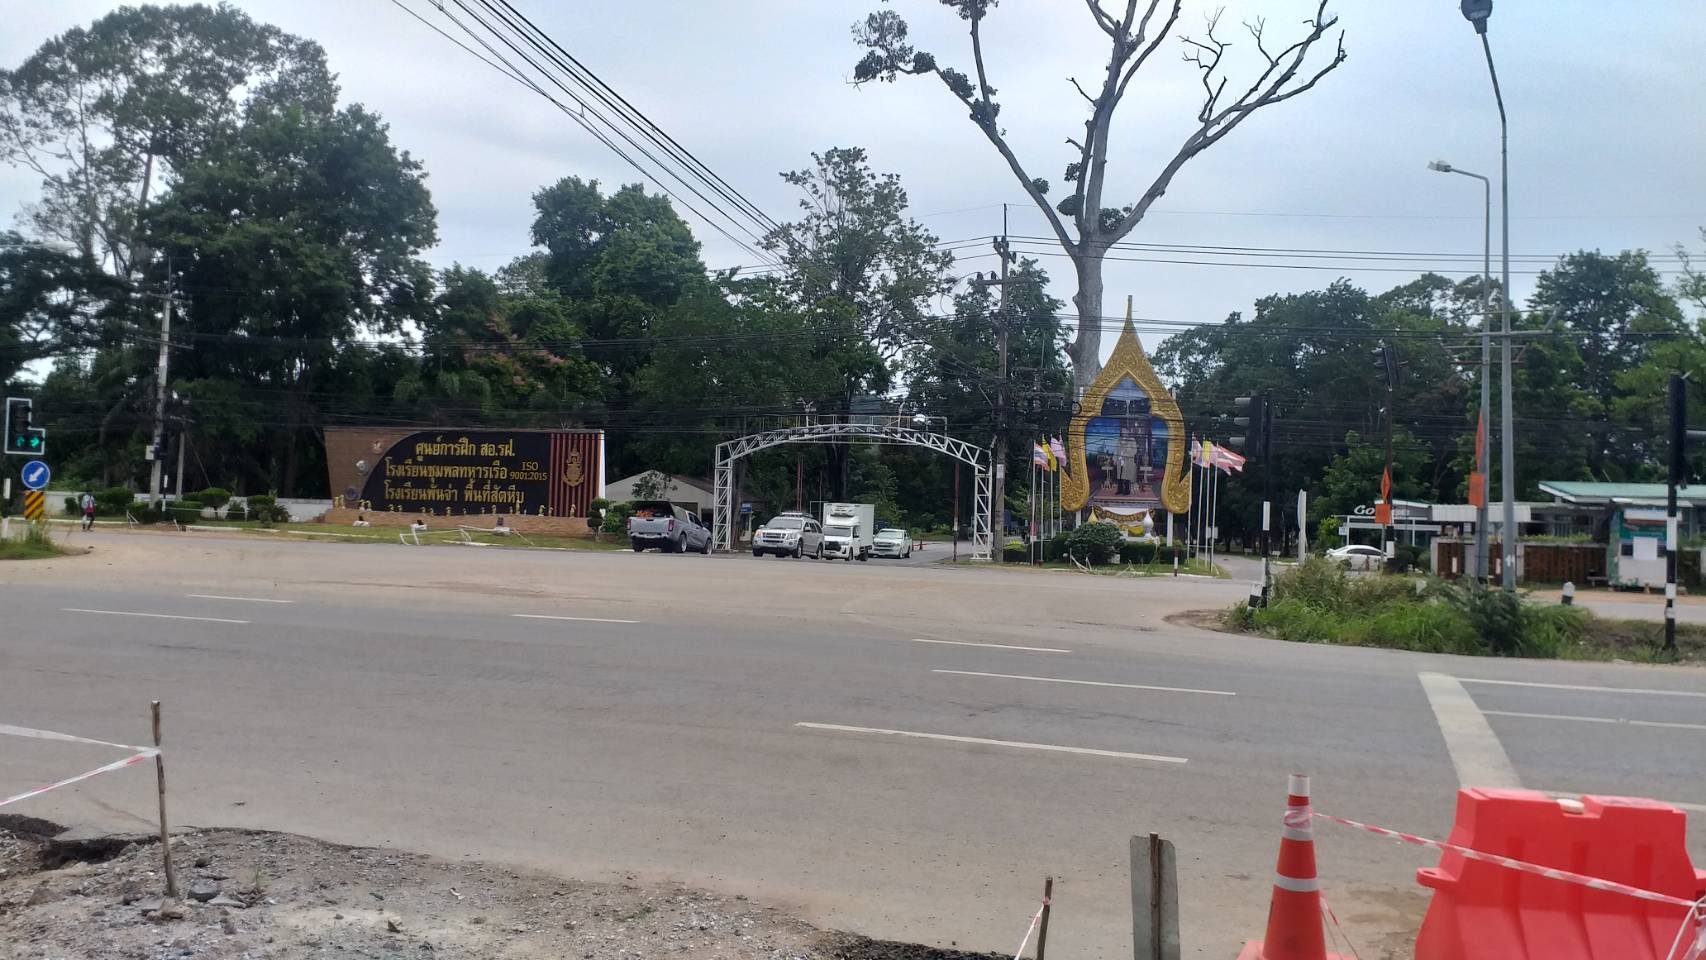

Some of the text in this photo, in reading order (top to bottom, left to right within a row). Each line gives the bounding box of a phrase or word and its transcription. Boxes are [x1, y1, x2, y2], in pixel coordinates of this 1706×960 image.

[415, 435, 476, 461] ศูนย์การฝึก
[384, 457, 508, 482] โรงเรียนชุมพลทหารเรือ
[509, 471, 548, 481] 9001:2015
[521, 461, 539, 471] ISO
[463, 478, 525, 504] พื้นที่สัตหีบ
